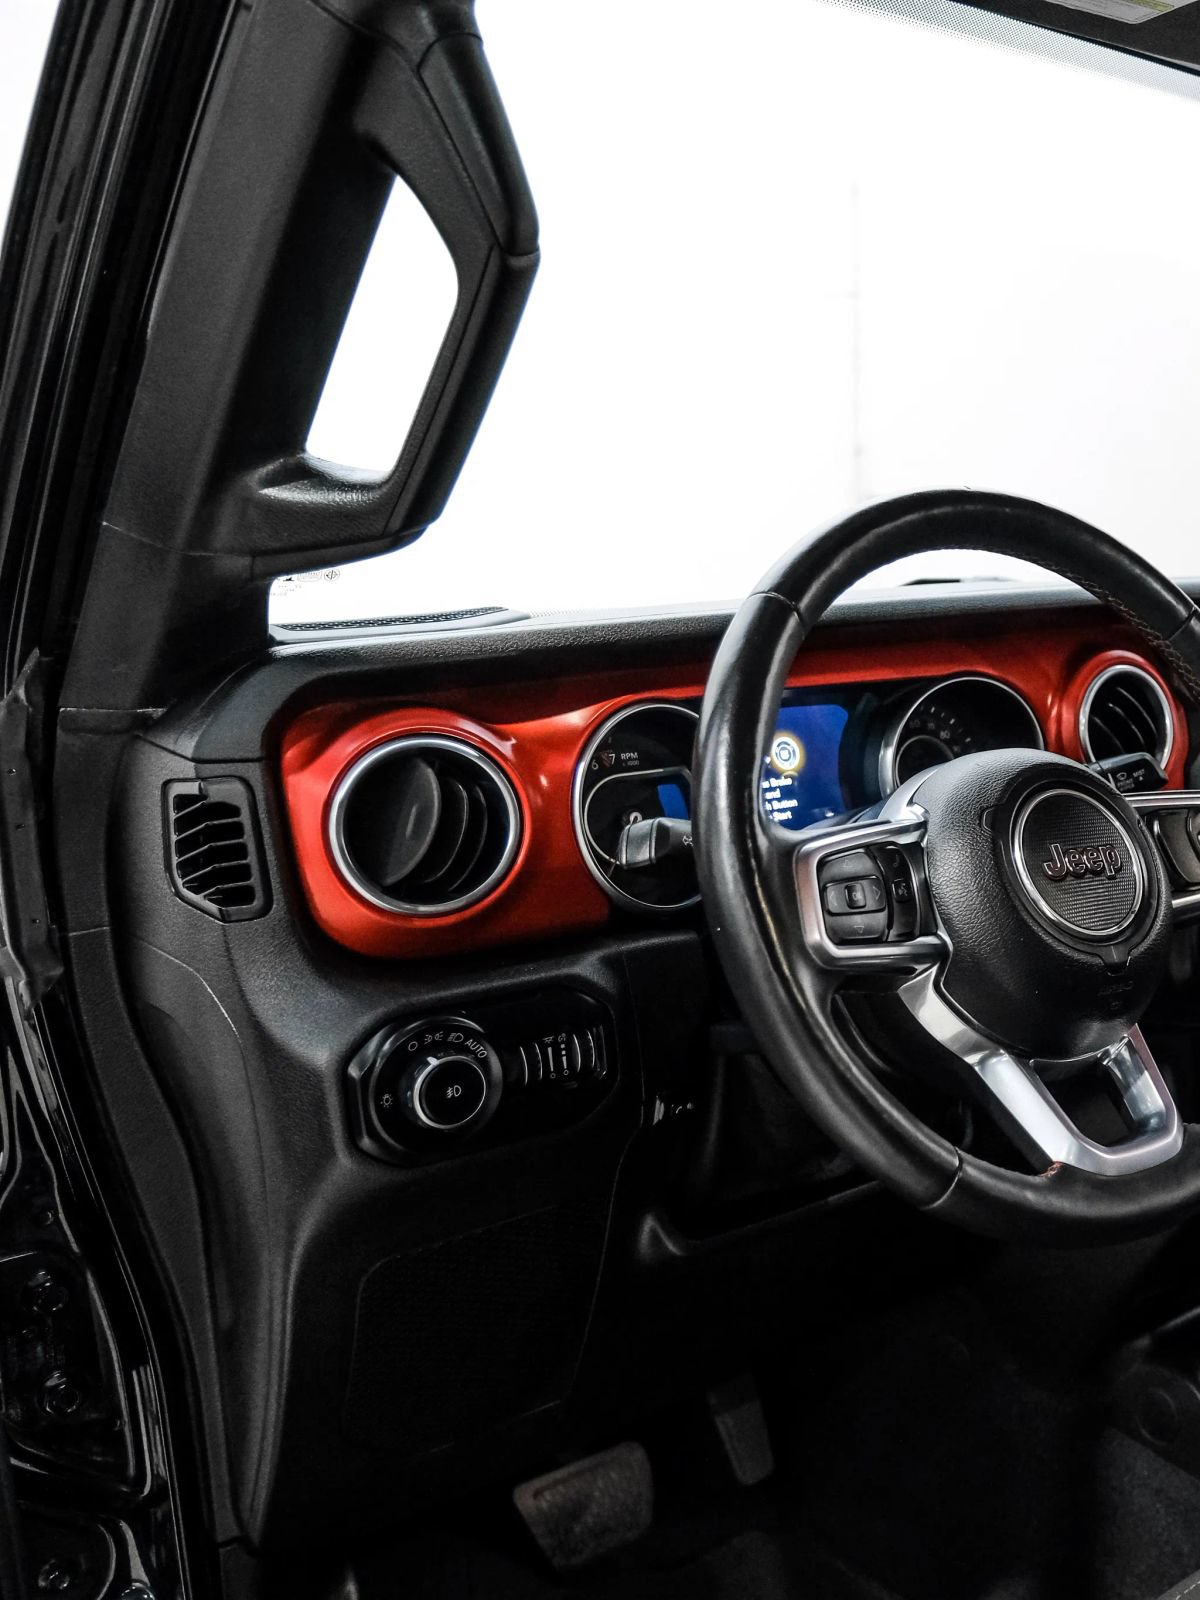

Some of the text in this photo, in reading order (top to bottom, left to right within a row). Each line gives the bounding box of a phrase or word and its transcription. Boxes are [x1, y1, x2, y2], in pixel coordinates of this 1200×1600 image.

[608, 753, 616, 765] 7
[620, 752, 639, 761] RPM
[591, 758, 599, 770] 6
[1042, 843, 1121, 877] Jeep
[464, 1038, 488, 1059] AUTO
